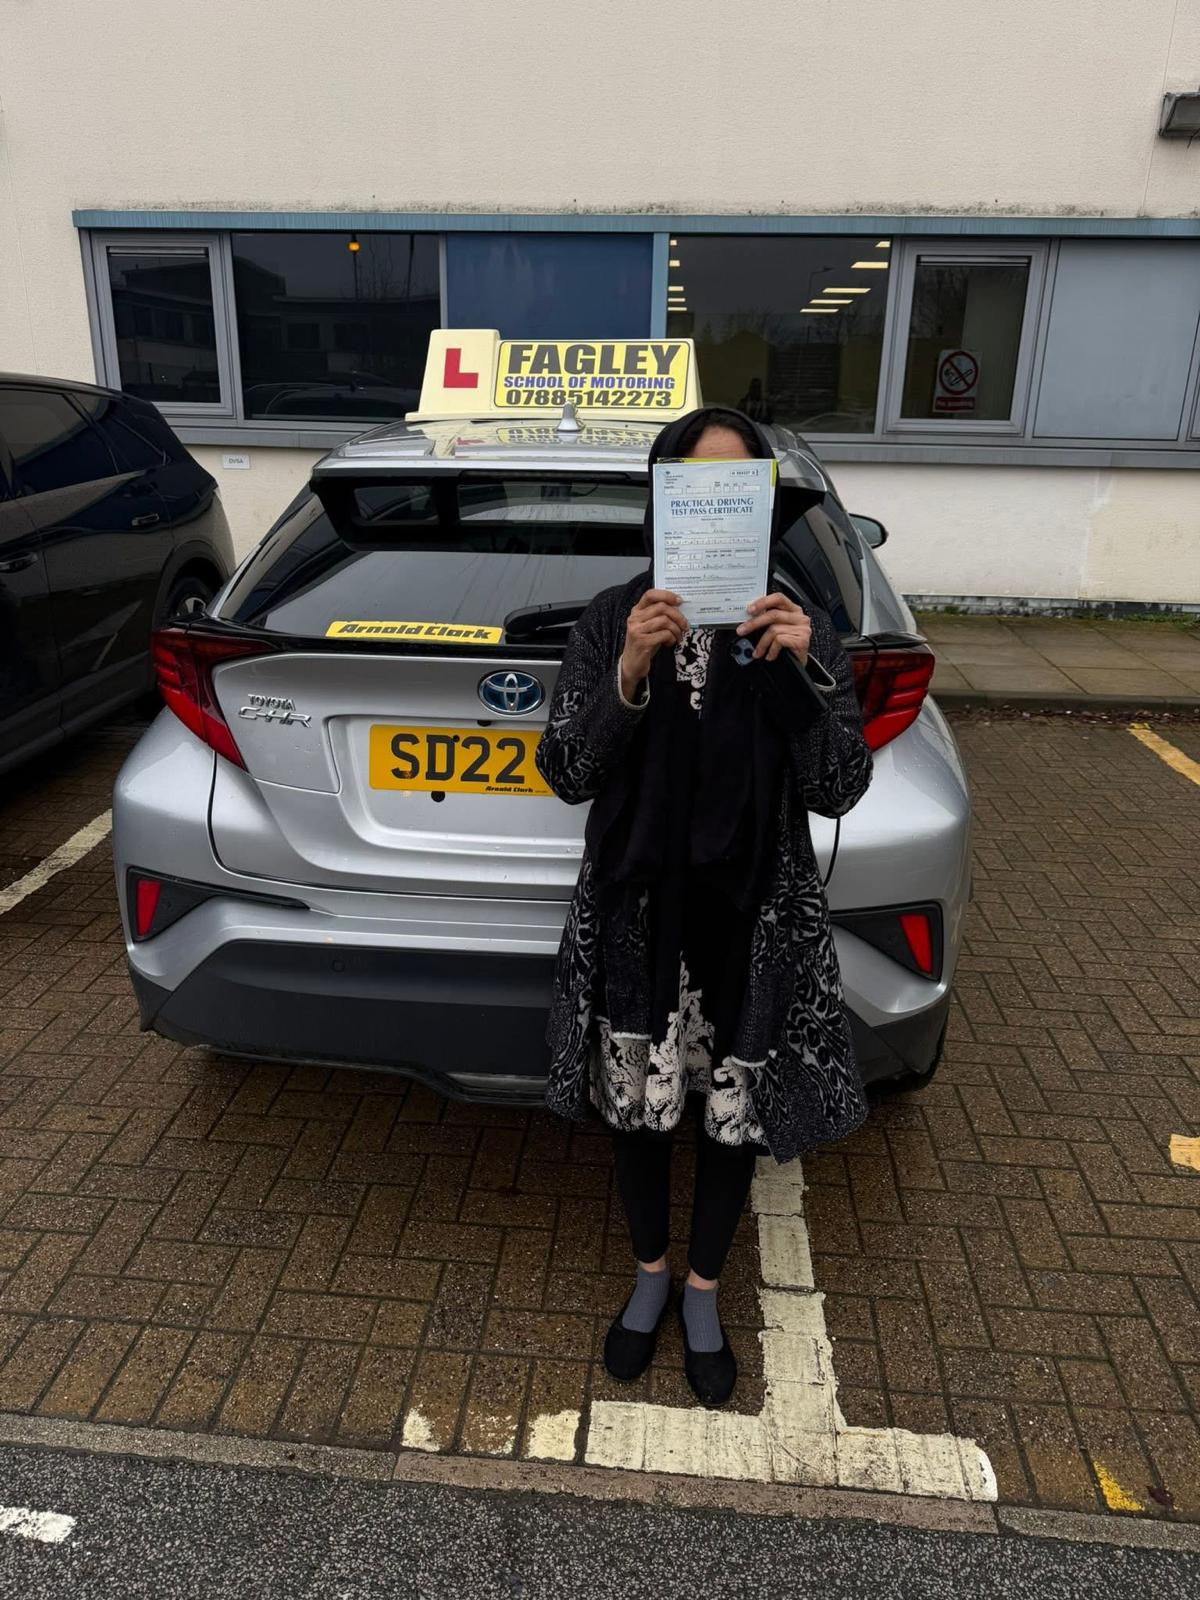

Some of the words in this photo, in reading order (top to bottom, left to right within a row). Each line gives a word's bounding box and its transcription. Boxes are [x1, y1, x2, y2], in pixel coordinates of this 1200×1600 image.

[443, 348, 479, 388] L
[508, 344, 681, 375] FAGLEY
[503, 376, 565, 388] SCHOOL
[568, 376, 588, 388] OF
[590, 376, 676, 389] MOTORING
[506, 389, 672, 407] 07885142273
[671, 498, 715, 508] PRACTICAL
[717, 497, 754, 507] DRIVING
[671, 508, 689, 516] TEST
[689, 507, 707, 515] PASS
[708, 506, 753, 515] CERTIFICATE
[338, 624, 424, 635] Arnold
[424, 626, 493, 639] Clark
[248, 694, 296, 711] TOYOTA
[239, 706, 312, 728] C-HR
[391, 733, 526, 784] SD22
